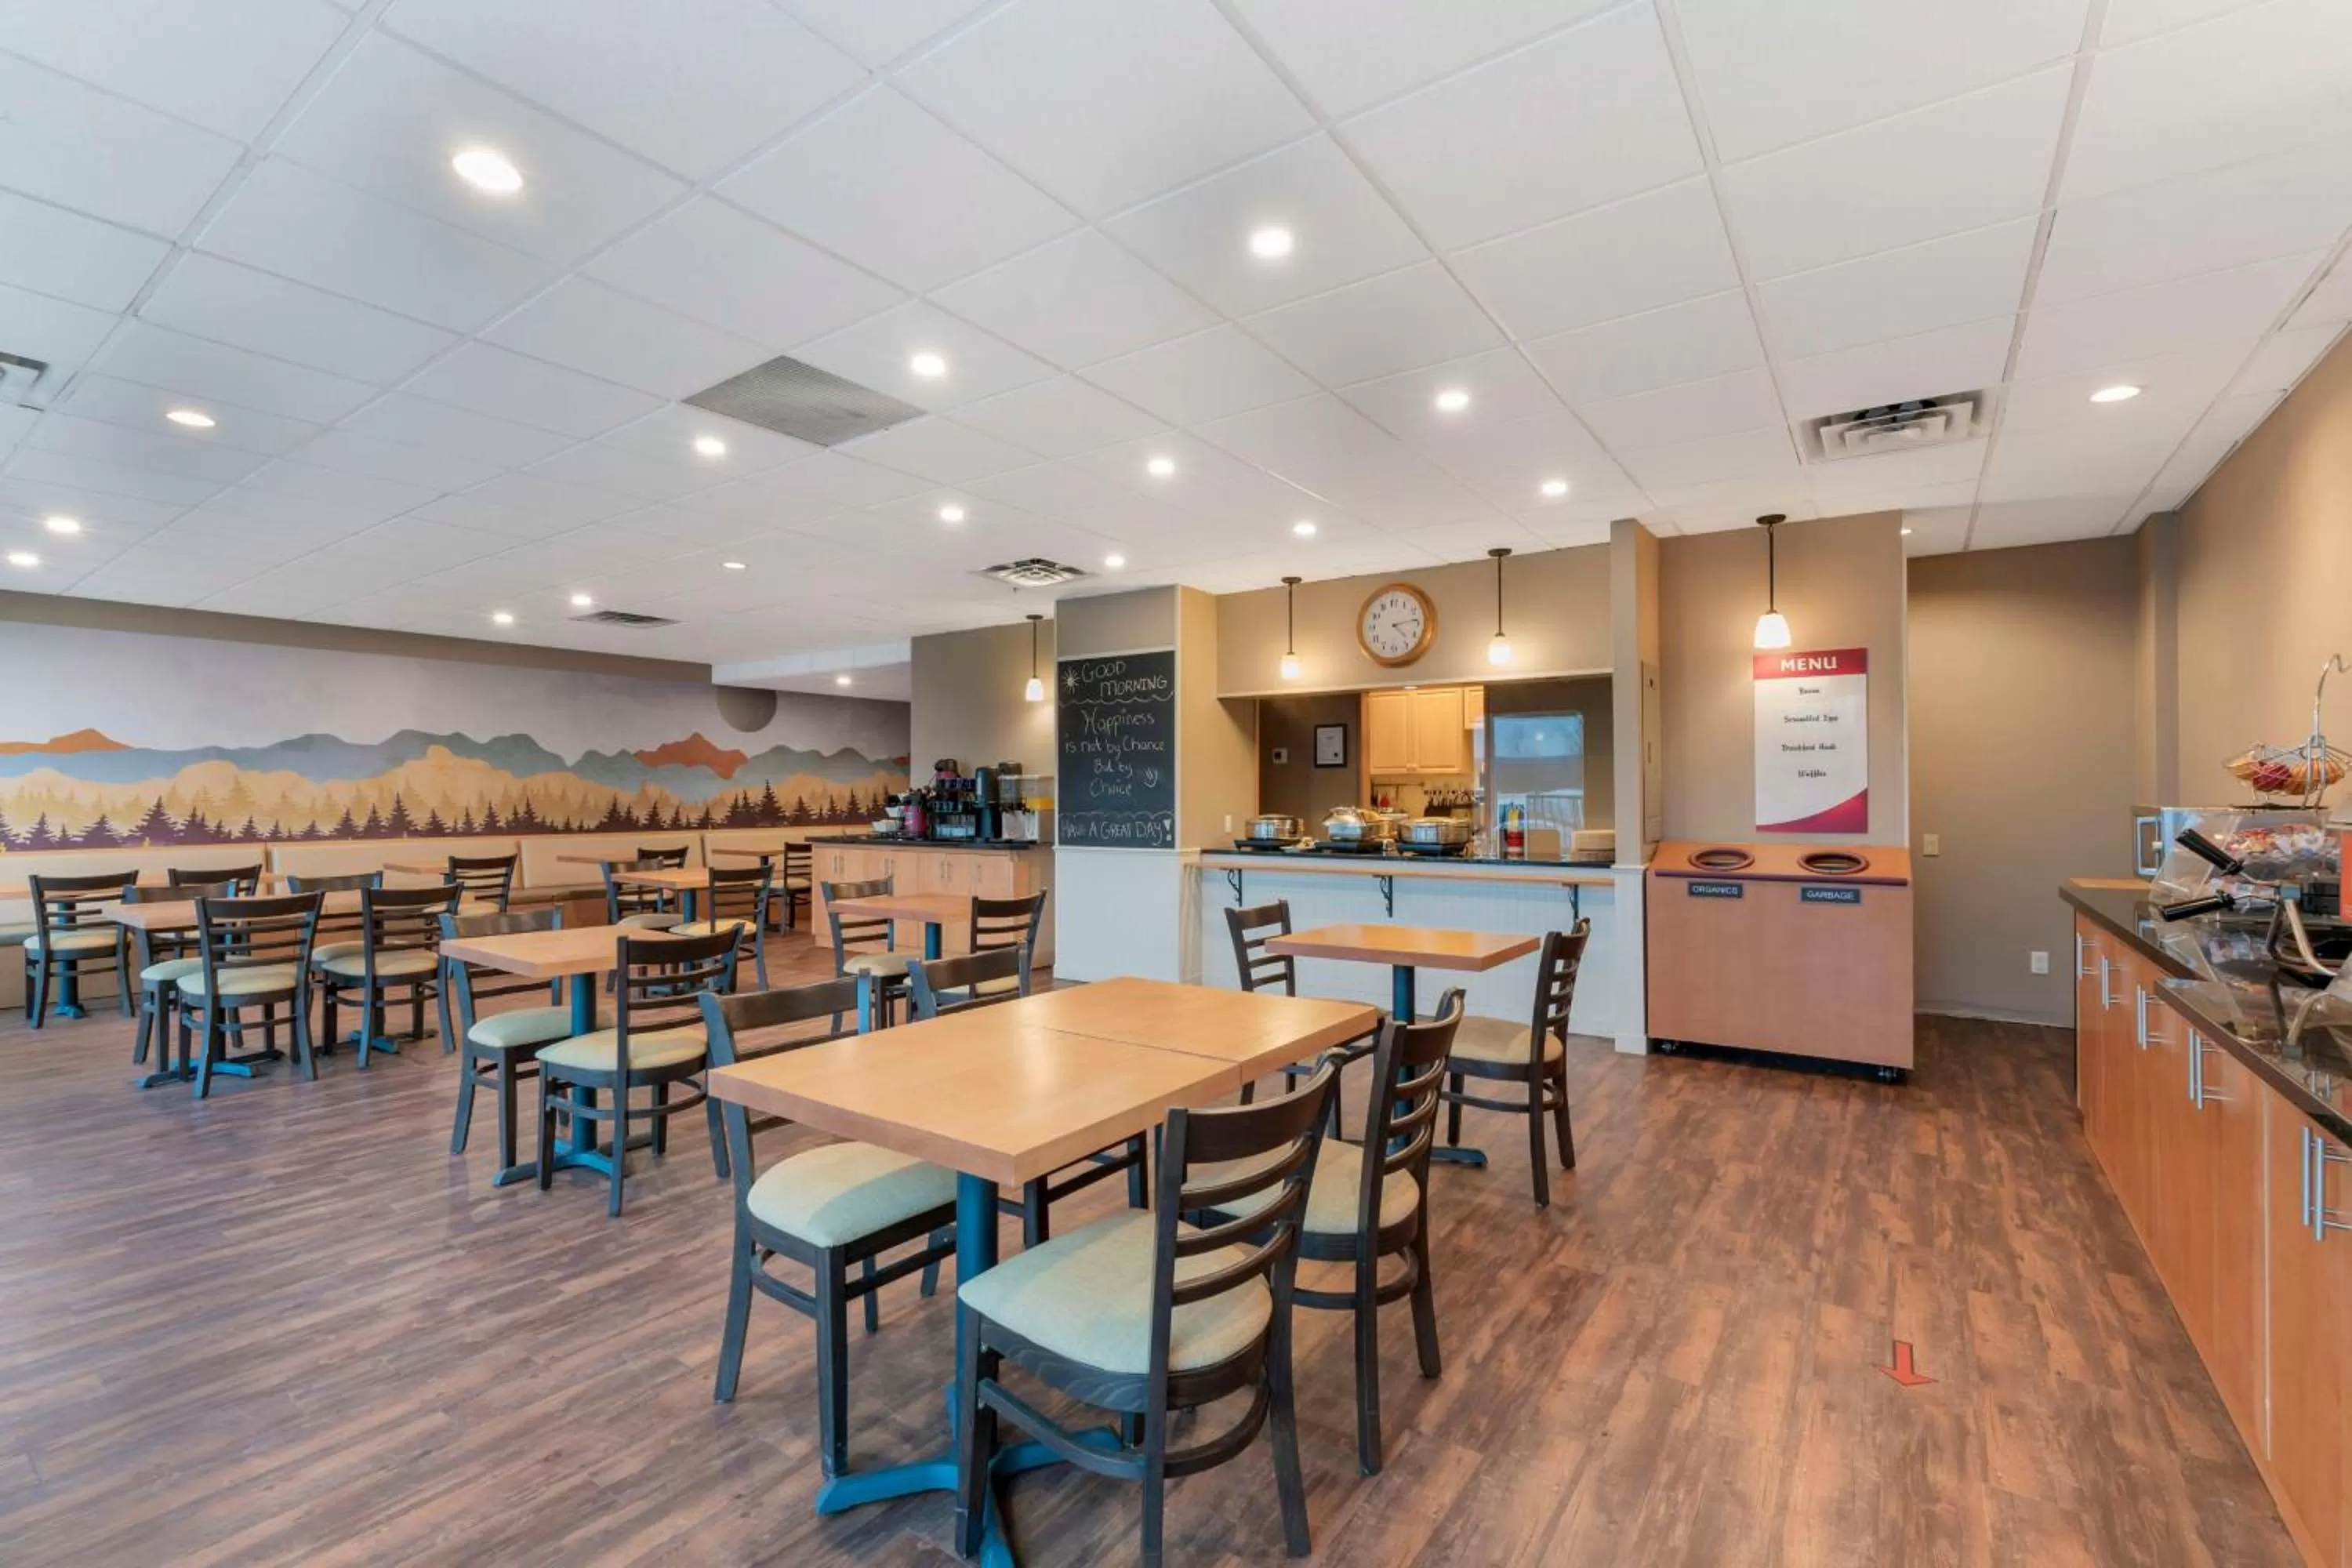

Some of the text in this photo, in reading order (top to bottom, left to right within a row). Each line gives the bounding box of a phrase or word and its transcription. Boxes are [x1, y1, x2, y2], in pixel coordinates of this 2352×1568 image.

[1080, 661, 1127, 684] GOOD
[1780, 655, 1838, 672] MENU
[1100, 675, 1168, 698] MORNING
[1080, 706, 1156, 737] Happiness
[1065, 733, 1165, 760] is not by Chance
[1088, 820, 1098, 838] A
[1691, 884, 1739, 895] ORGANICS
[1806, 890, 1855, 901] GARBAGE
